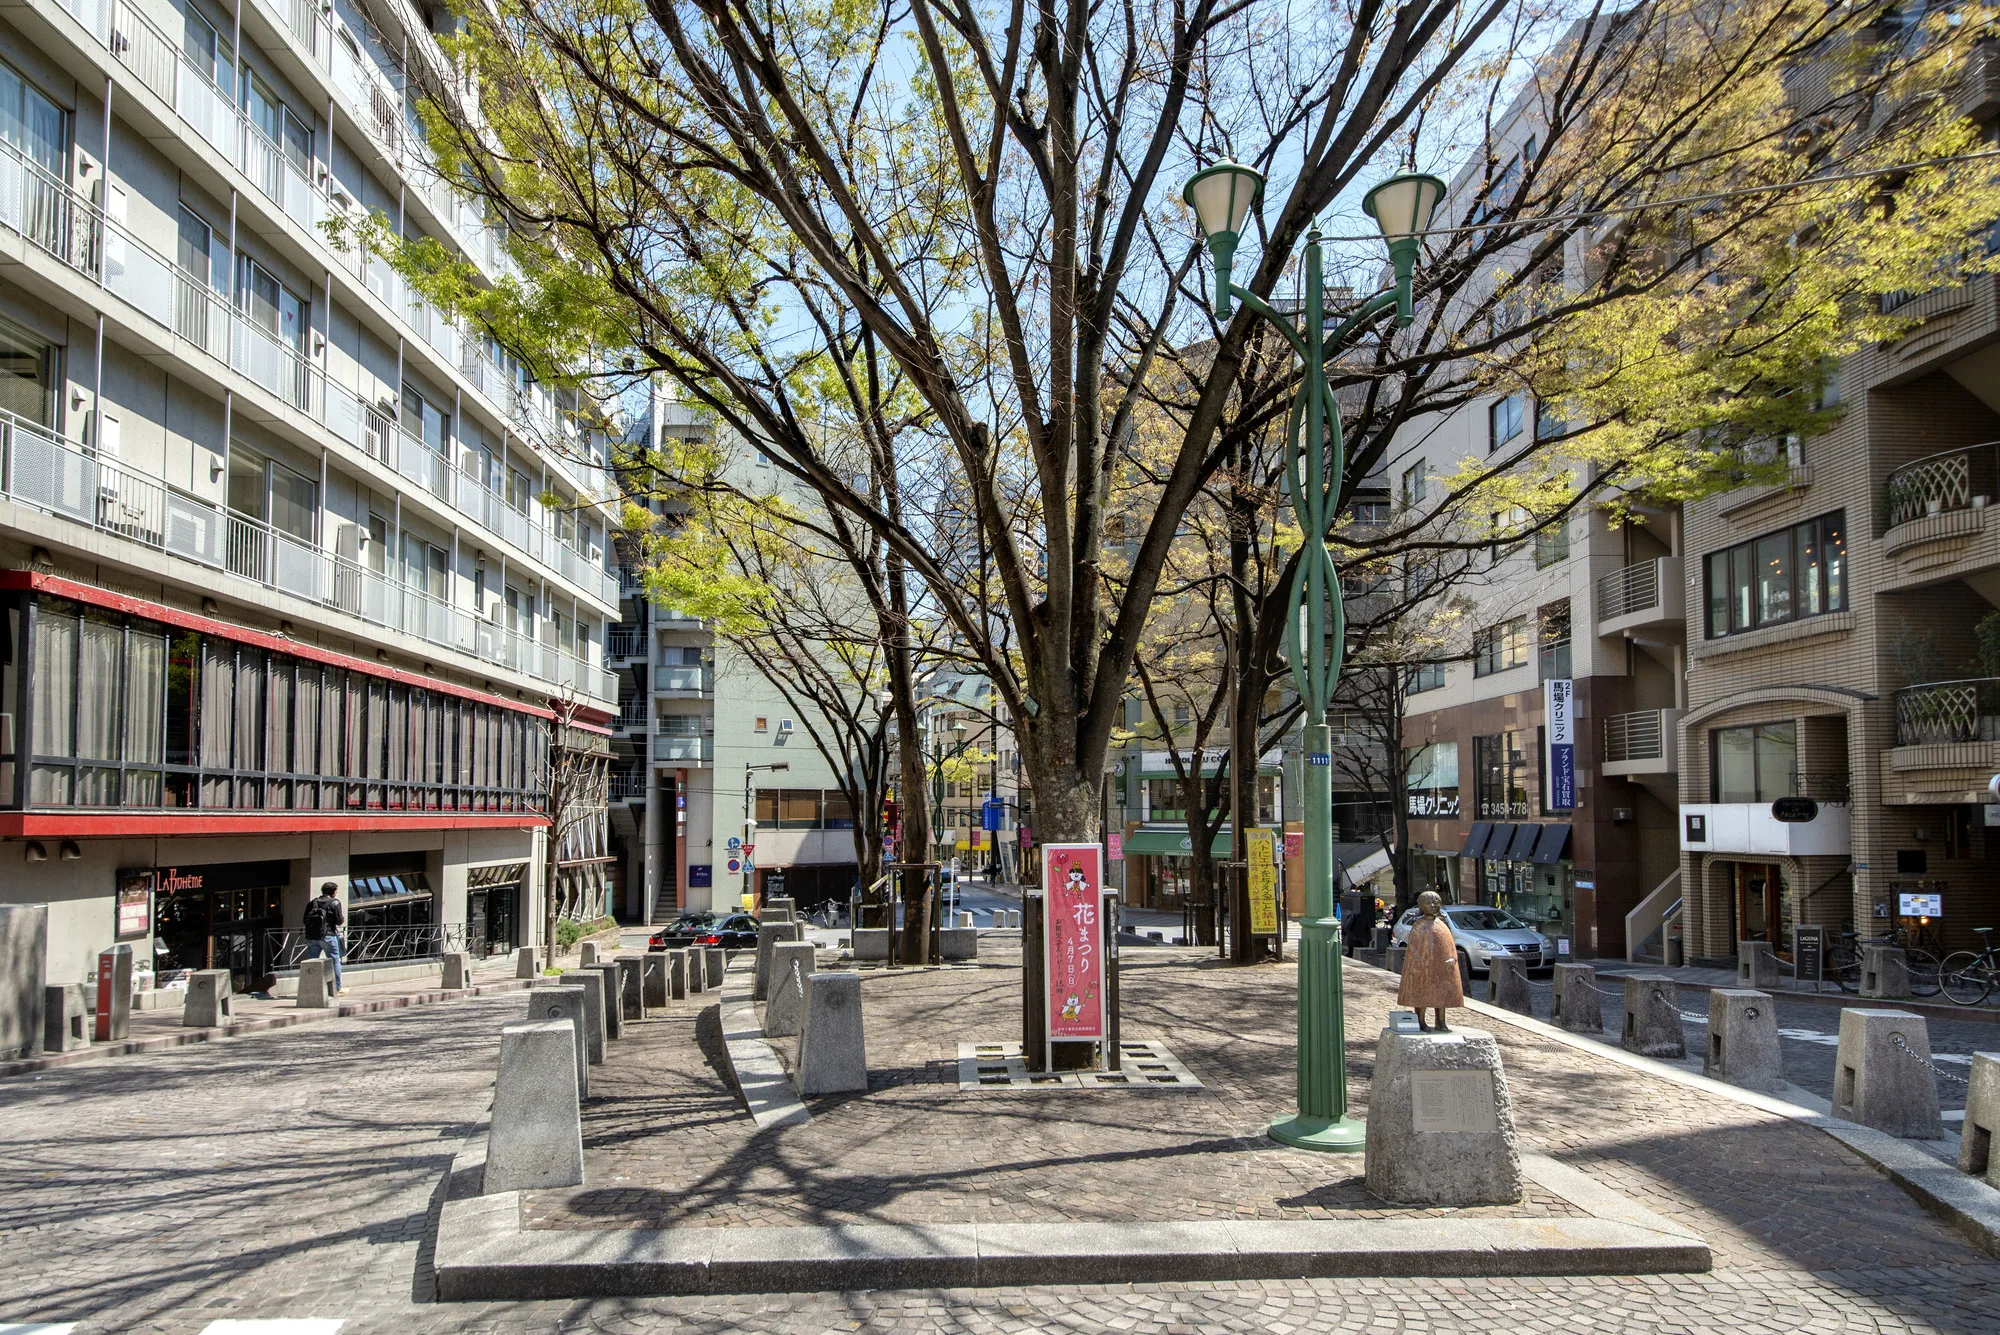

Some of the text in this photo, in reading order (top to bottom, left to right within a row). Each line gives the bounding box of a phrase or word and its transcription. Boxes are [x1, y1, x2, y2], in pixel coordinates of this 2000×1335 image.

[1553, 682, 1565, 741] 馬場クリニック
[1565, 682, 1571, 697] 2F
[1560, 748, 1571, 806] ブランド宝石買取
[1408, 795, 1460, 816] 馬場クリニック
[1490, 802, 1529, 815] 3454-778
[1258, 839, 1276, 927] ハトにエサを与えること禁止
[1066, 937, 1076, 988] 4月7日(日)
[1073, 903, 1095, 974] 花まつり
